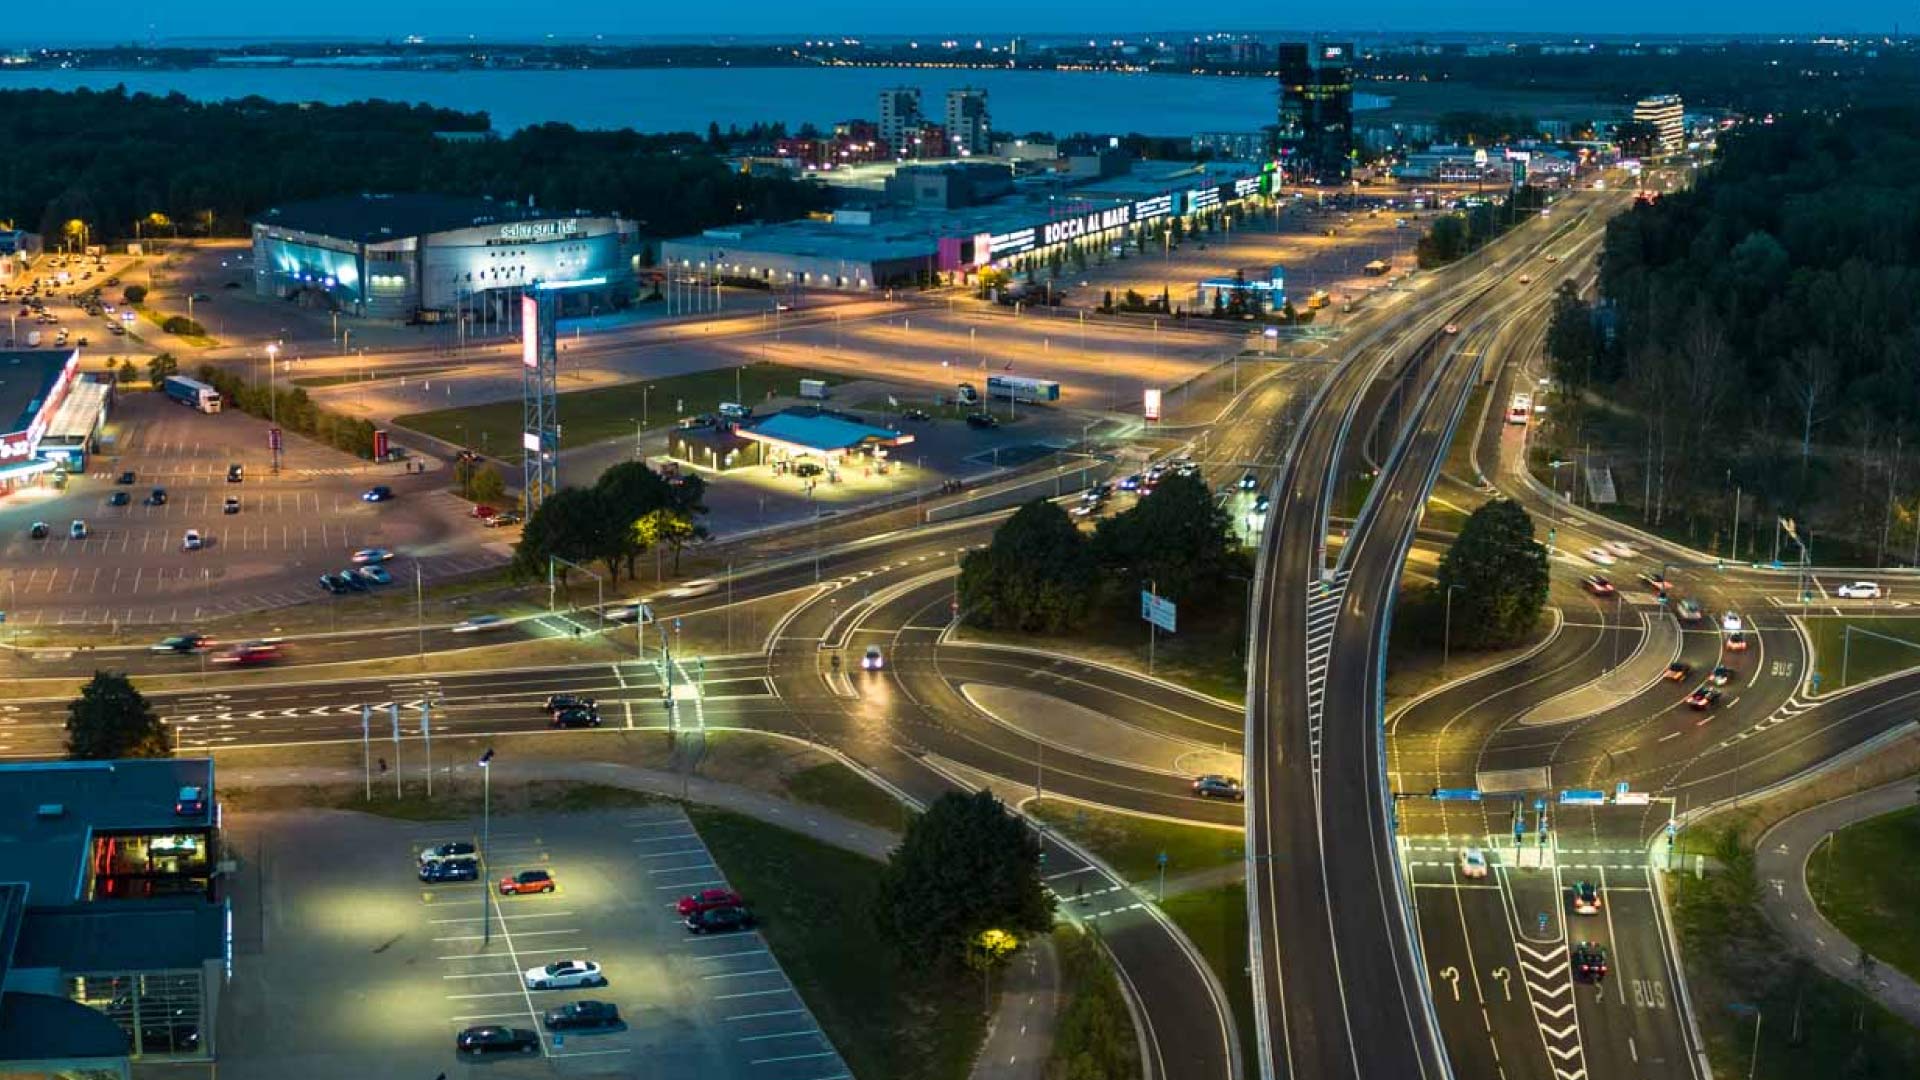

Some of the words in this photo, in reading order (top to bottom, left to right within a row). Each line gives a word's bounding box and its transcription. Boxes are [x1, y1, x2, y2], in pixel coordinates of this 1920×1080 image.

[1045, 217, 1084, 244] ROCCA
[1087, 213, 1100, 232] AL
[1103, 205, 1130, 229] MARE
[1771, 661, 1794, 677] BUS
[1632, 979, 1666, 1009] BUS
